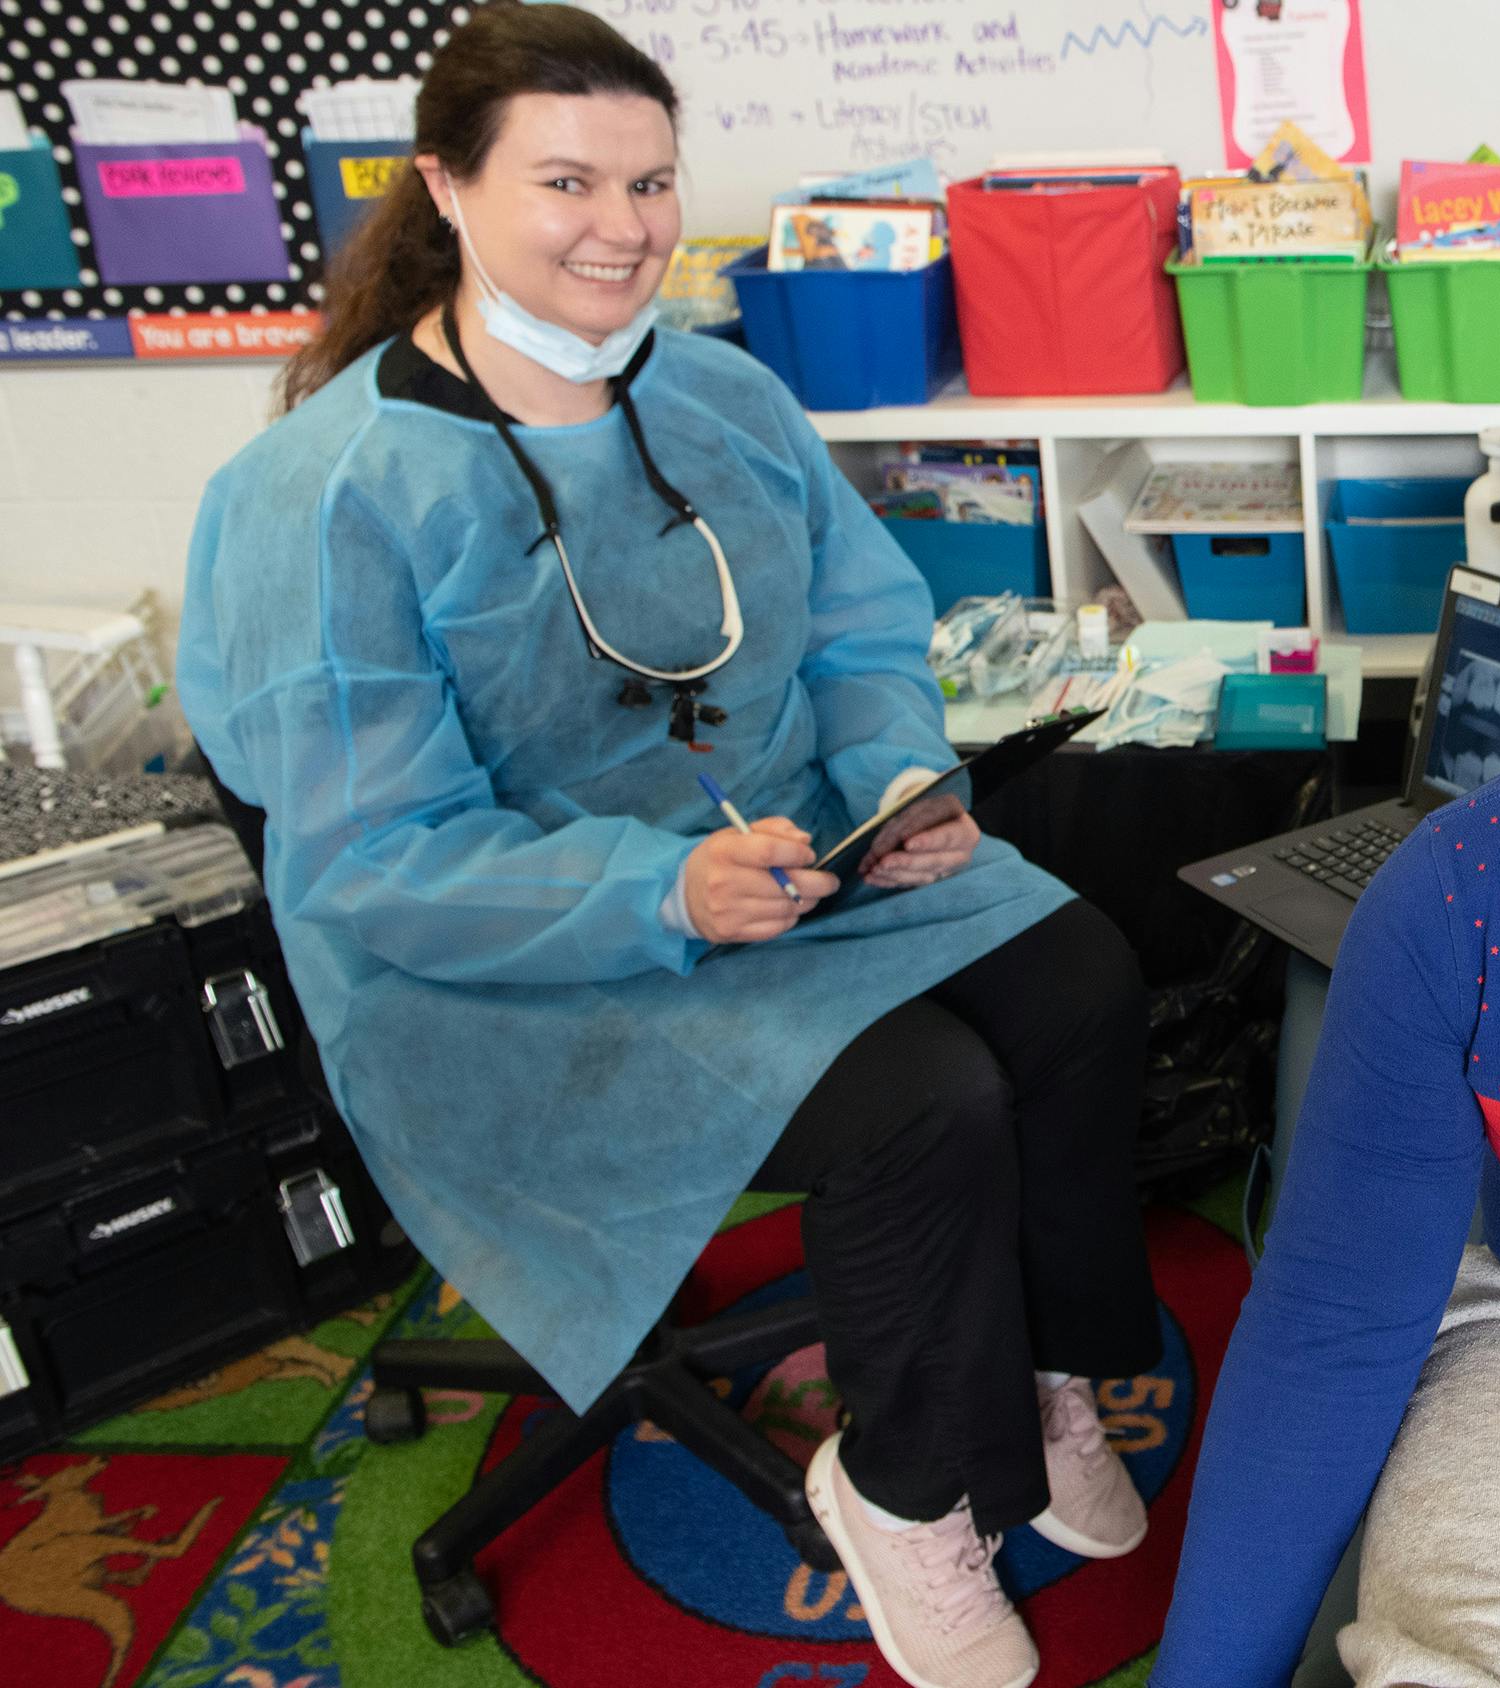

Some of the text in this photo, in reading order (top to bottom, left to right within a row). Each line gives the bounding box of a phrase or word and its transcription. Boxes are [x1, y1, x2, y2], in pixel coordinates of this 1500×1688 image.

[812, 11, 950, 54] Homework
[972, 9, 1019, 43] and
[832, 45, 1057, 82] Academic Activities
[1204, 194, 1246, 220] How
[1411, 195, 1484, 226] Lacey
[1248, 221, 1313, 247] Pirate
[139, 324, 185, 348] You
[187, 326, 233, 348] are
[22, 986, 92, 1019] HUSKY
[109, 1196, 175, 1234] HUSKY
